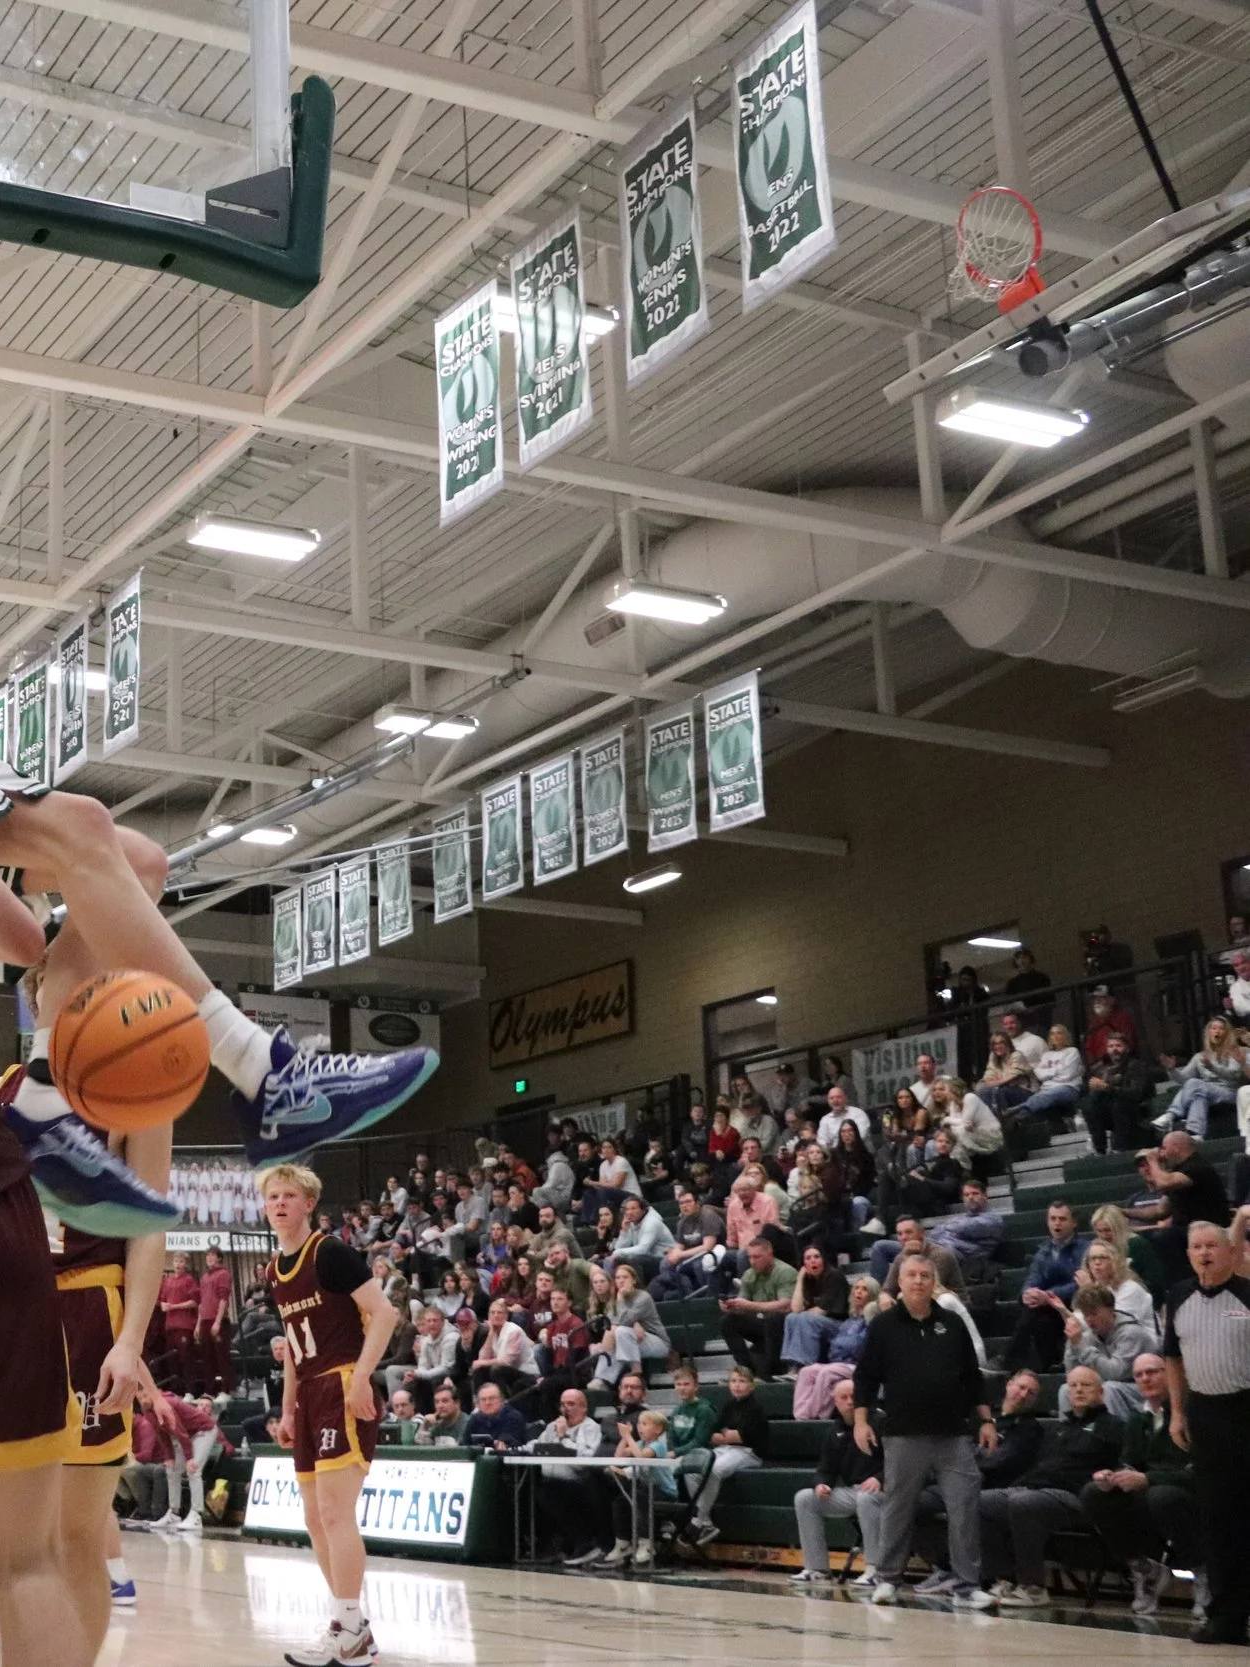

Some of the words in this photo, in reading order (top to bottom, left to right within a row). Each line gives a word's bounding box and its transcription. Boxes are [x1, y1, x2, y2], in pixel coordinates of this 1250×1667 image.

[741, 44, 805, 118] STATE
[626, 137, 689, 206] STATE
[768, 211, 800, 254] 222
[642, 268, 686, 313] TENNIS
[646, 294, 680, 333] 2022
[442, 314, 492, 365] STATE
[447, 423, 497, 464] WIMMNG
[709, 695, 750, 724] STATE
[651, 722, 689, 748] STATE
[586, 743, 619, 770] STATE
[720, 762, 745, 779] MEN'S
[535, 767, 567, 793] STATE
[660, 786, 683, 801] MEN'S
[486, 788, 515, 812] STATE
[585, 806, 617, 822] WOMEN'
[308, 879, 331, 897] STATE
[342, 867, 368, 883] STATE
[278, 896, 299, 912] STATE
[489, 983, 627, 1058] Olympus
[166, 1235, 201, 1246] NIANS
[286, 1316, 317, 1367] 11
[251, 1478, 301, 1508] OLYM
[361, 1487, 465, 1536] TITANS
